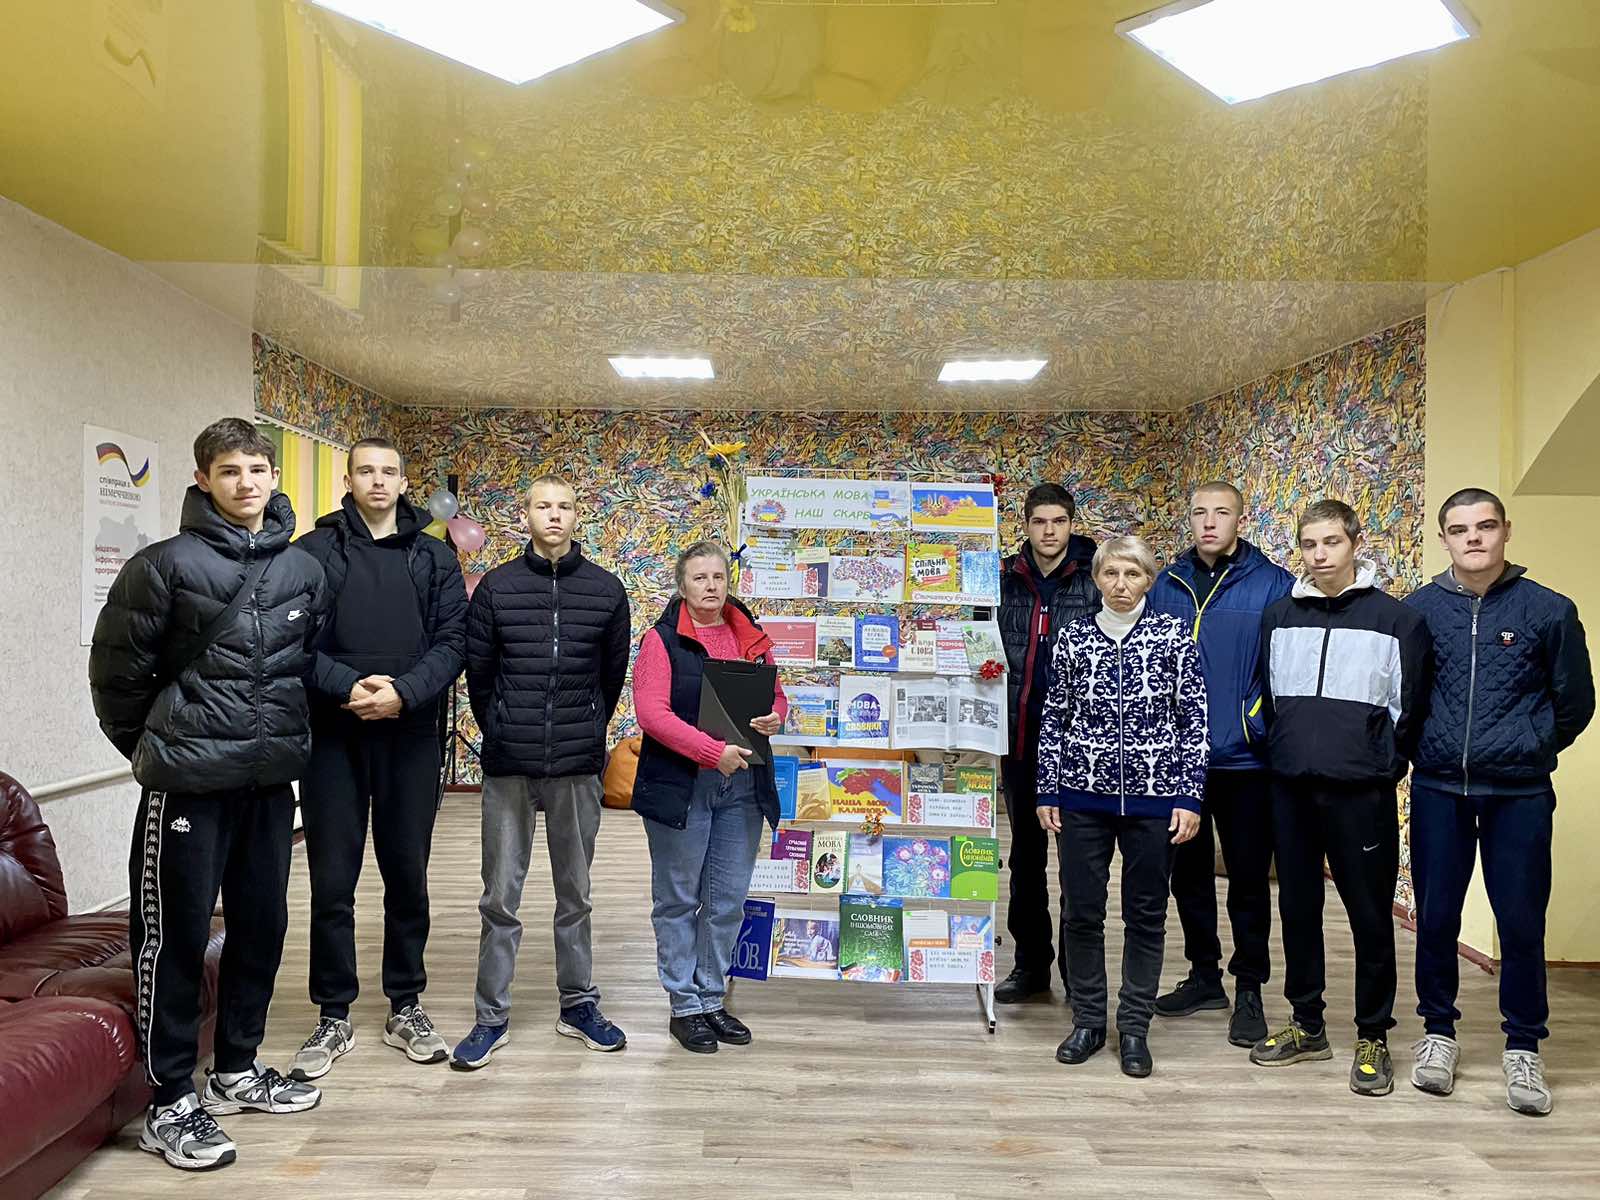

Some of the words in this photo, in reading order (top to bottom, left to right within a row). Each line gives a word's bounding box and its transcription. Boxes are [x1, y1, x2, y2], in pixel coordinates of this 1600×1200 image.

[751, 488, 826, 499] УКРАЇНСЬКА
[795, 508, 824, 518] НАШ
[832, 508, 870, 520] СКАРБ
[917, 568, 941, 577] МОВА
[817, 840, 842, 848] МОВА
[850, 913, 894, 924] СЛОВНИК
